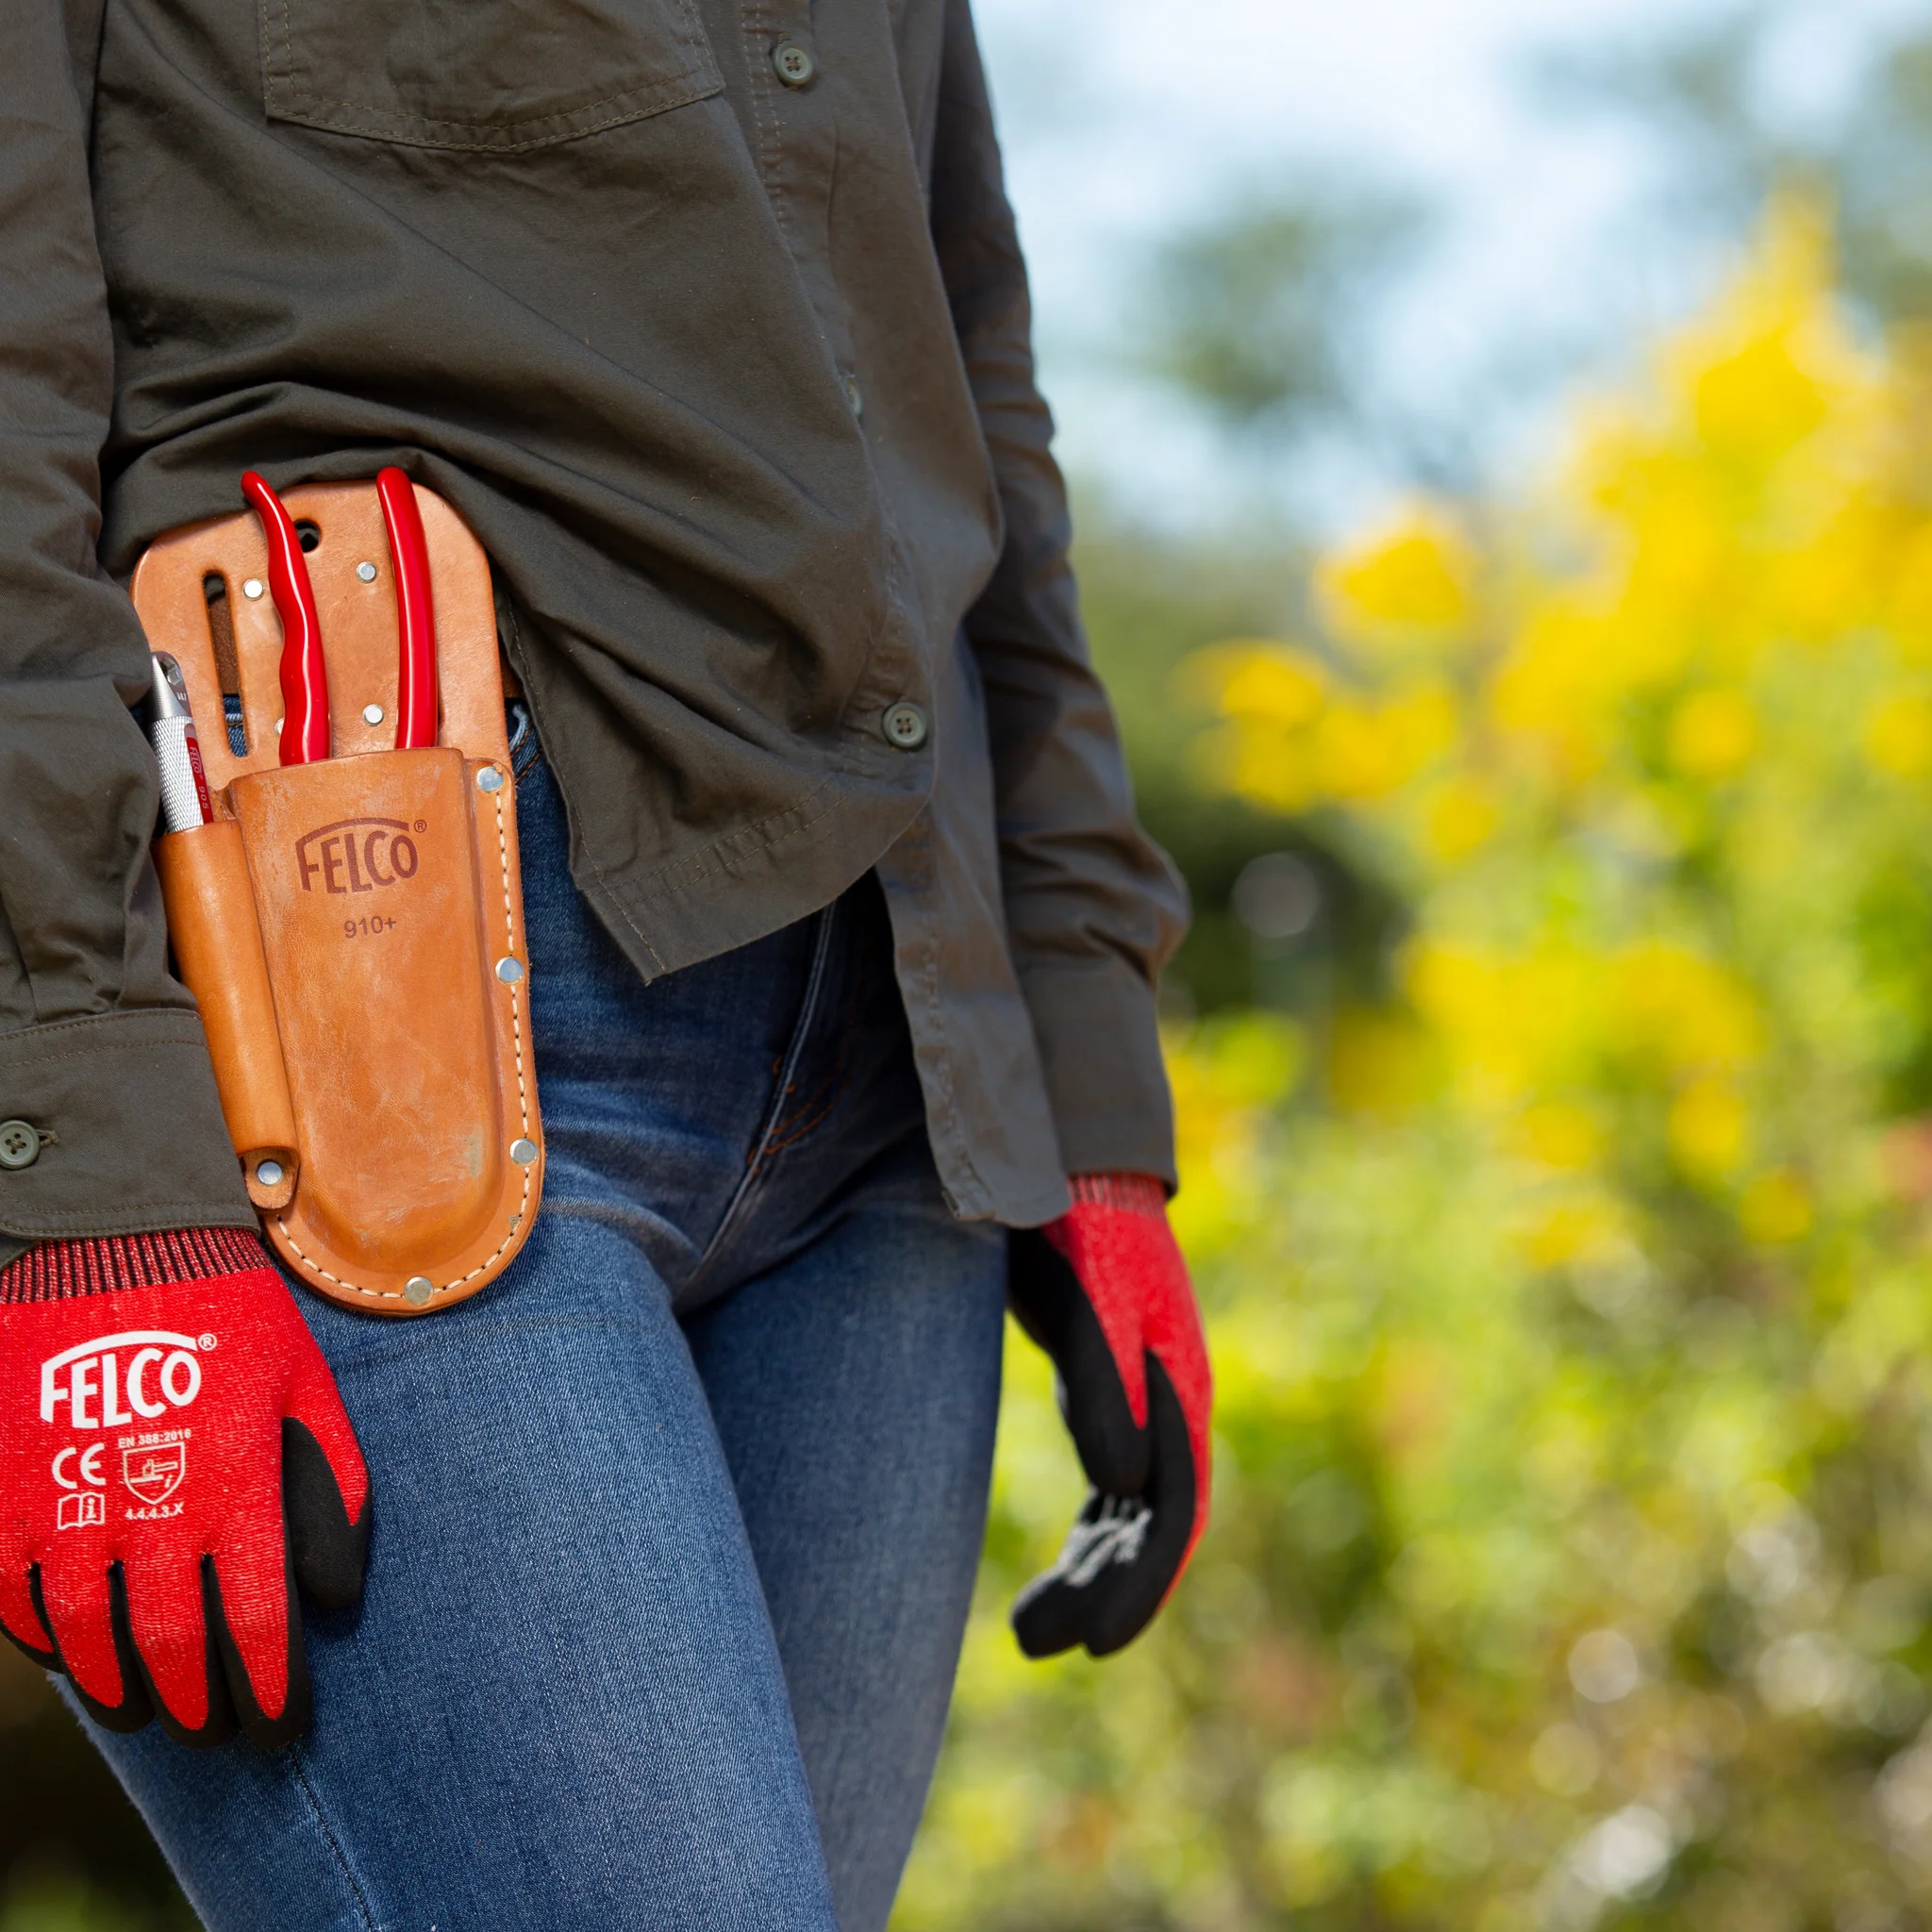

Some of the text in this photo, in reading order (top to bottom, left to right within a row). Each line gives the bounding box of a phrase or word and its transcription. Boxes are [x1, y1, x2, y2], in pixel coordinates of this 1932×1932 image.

[343, 916, 396, 939] 910+
[118, 1428, 192, 1449] EN 388:2016
[52, 1442, 106, 1490] CE
